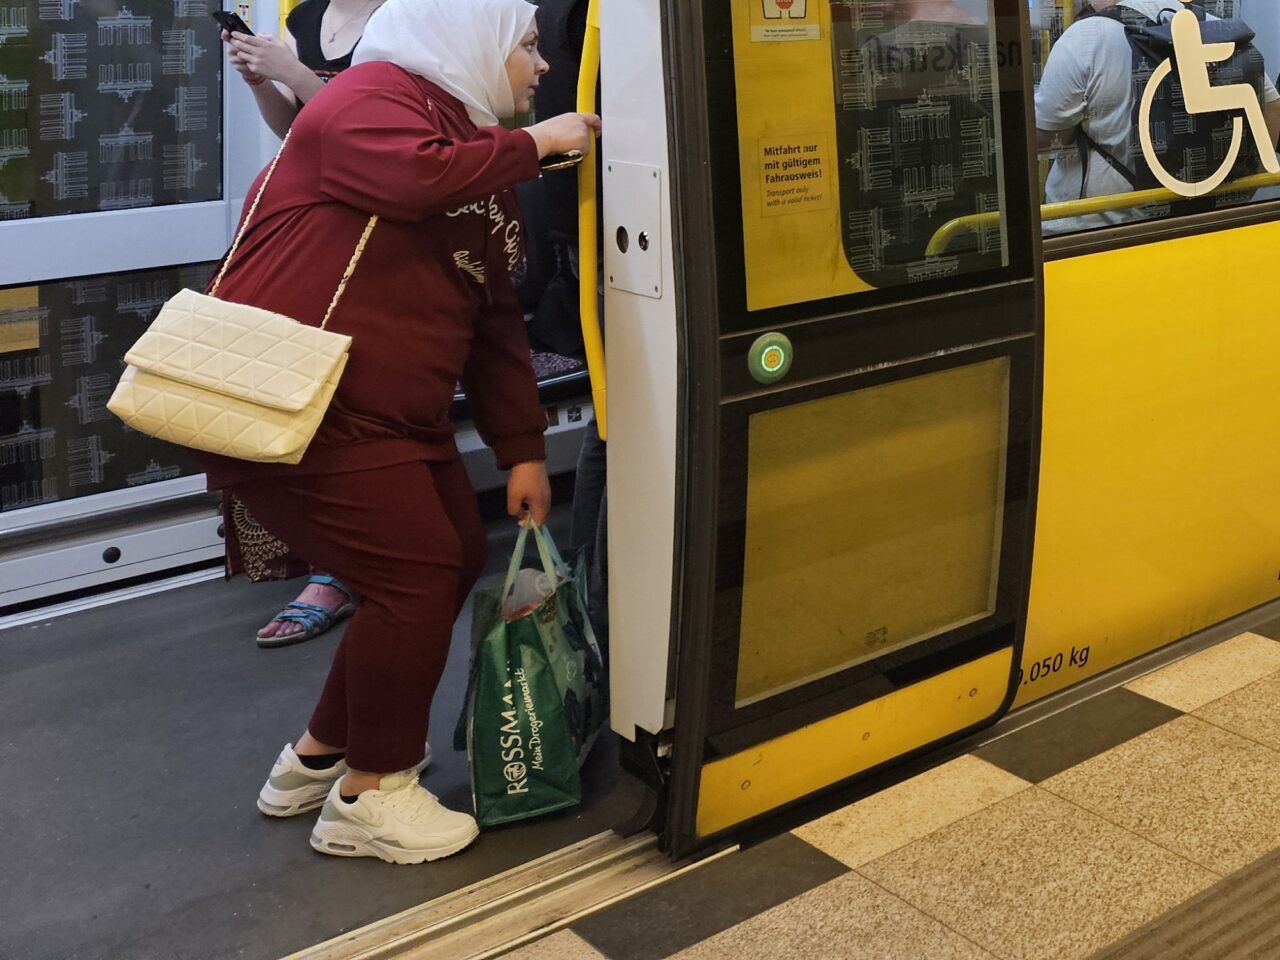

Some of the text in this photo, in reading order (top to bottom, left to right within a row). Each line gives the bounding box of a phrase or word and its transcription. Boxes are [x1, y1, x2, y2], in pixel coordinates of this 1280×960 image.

[764, 144, 818, 157] Mitfahrt nur
[764, 157, 820, 171] mit gültigem
[765, 169, 822, 184] Fahrausweis!
[767, 187, 795, 198] Transport
[1069, 645, 1090, 668] kg
[514, 667, 544, 771] Mein Drogeriemarkt
